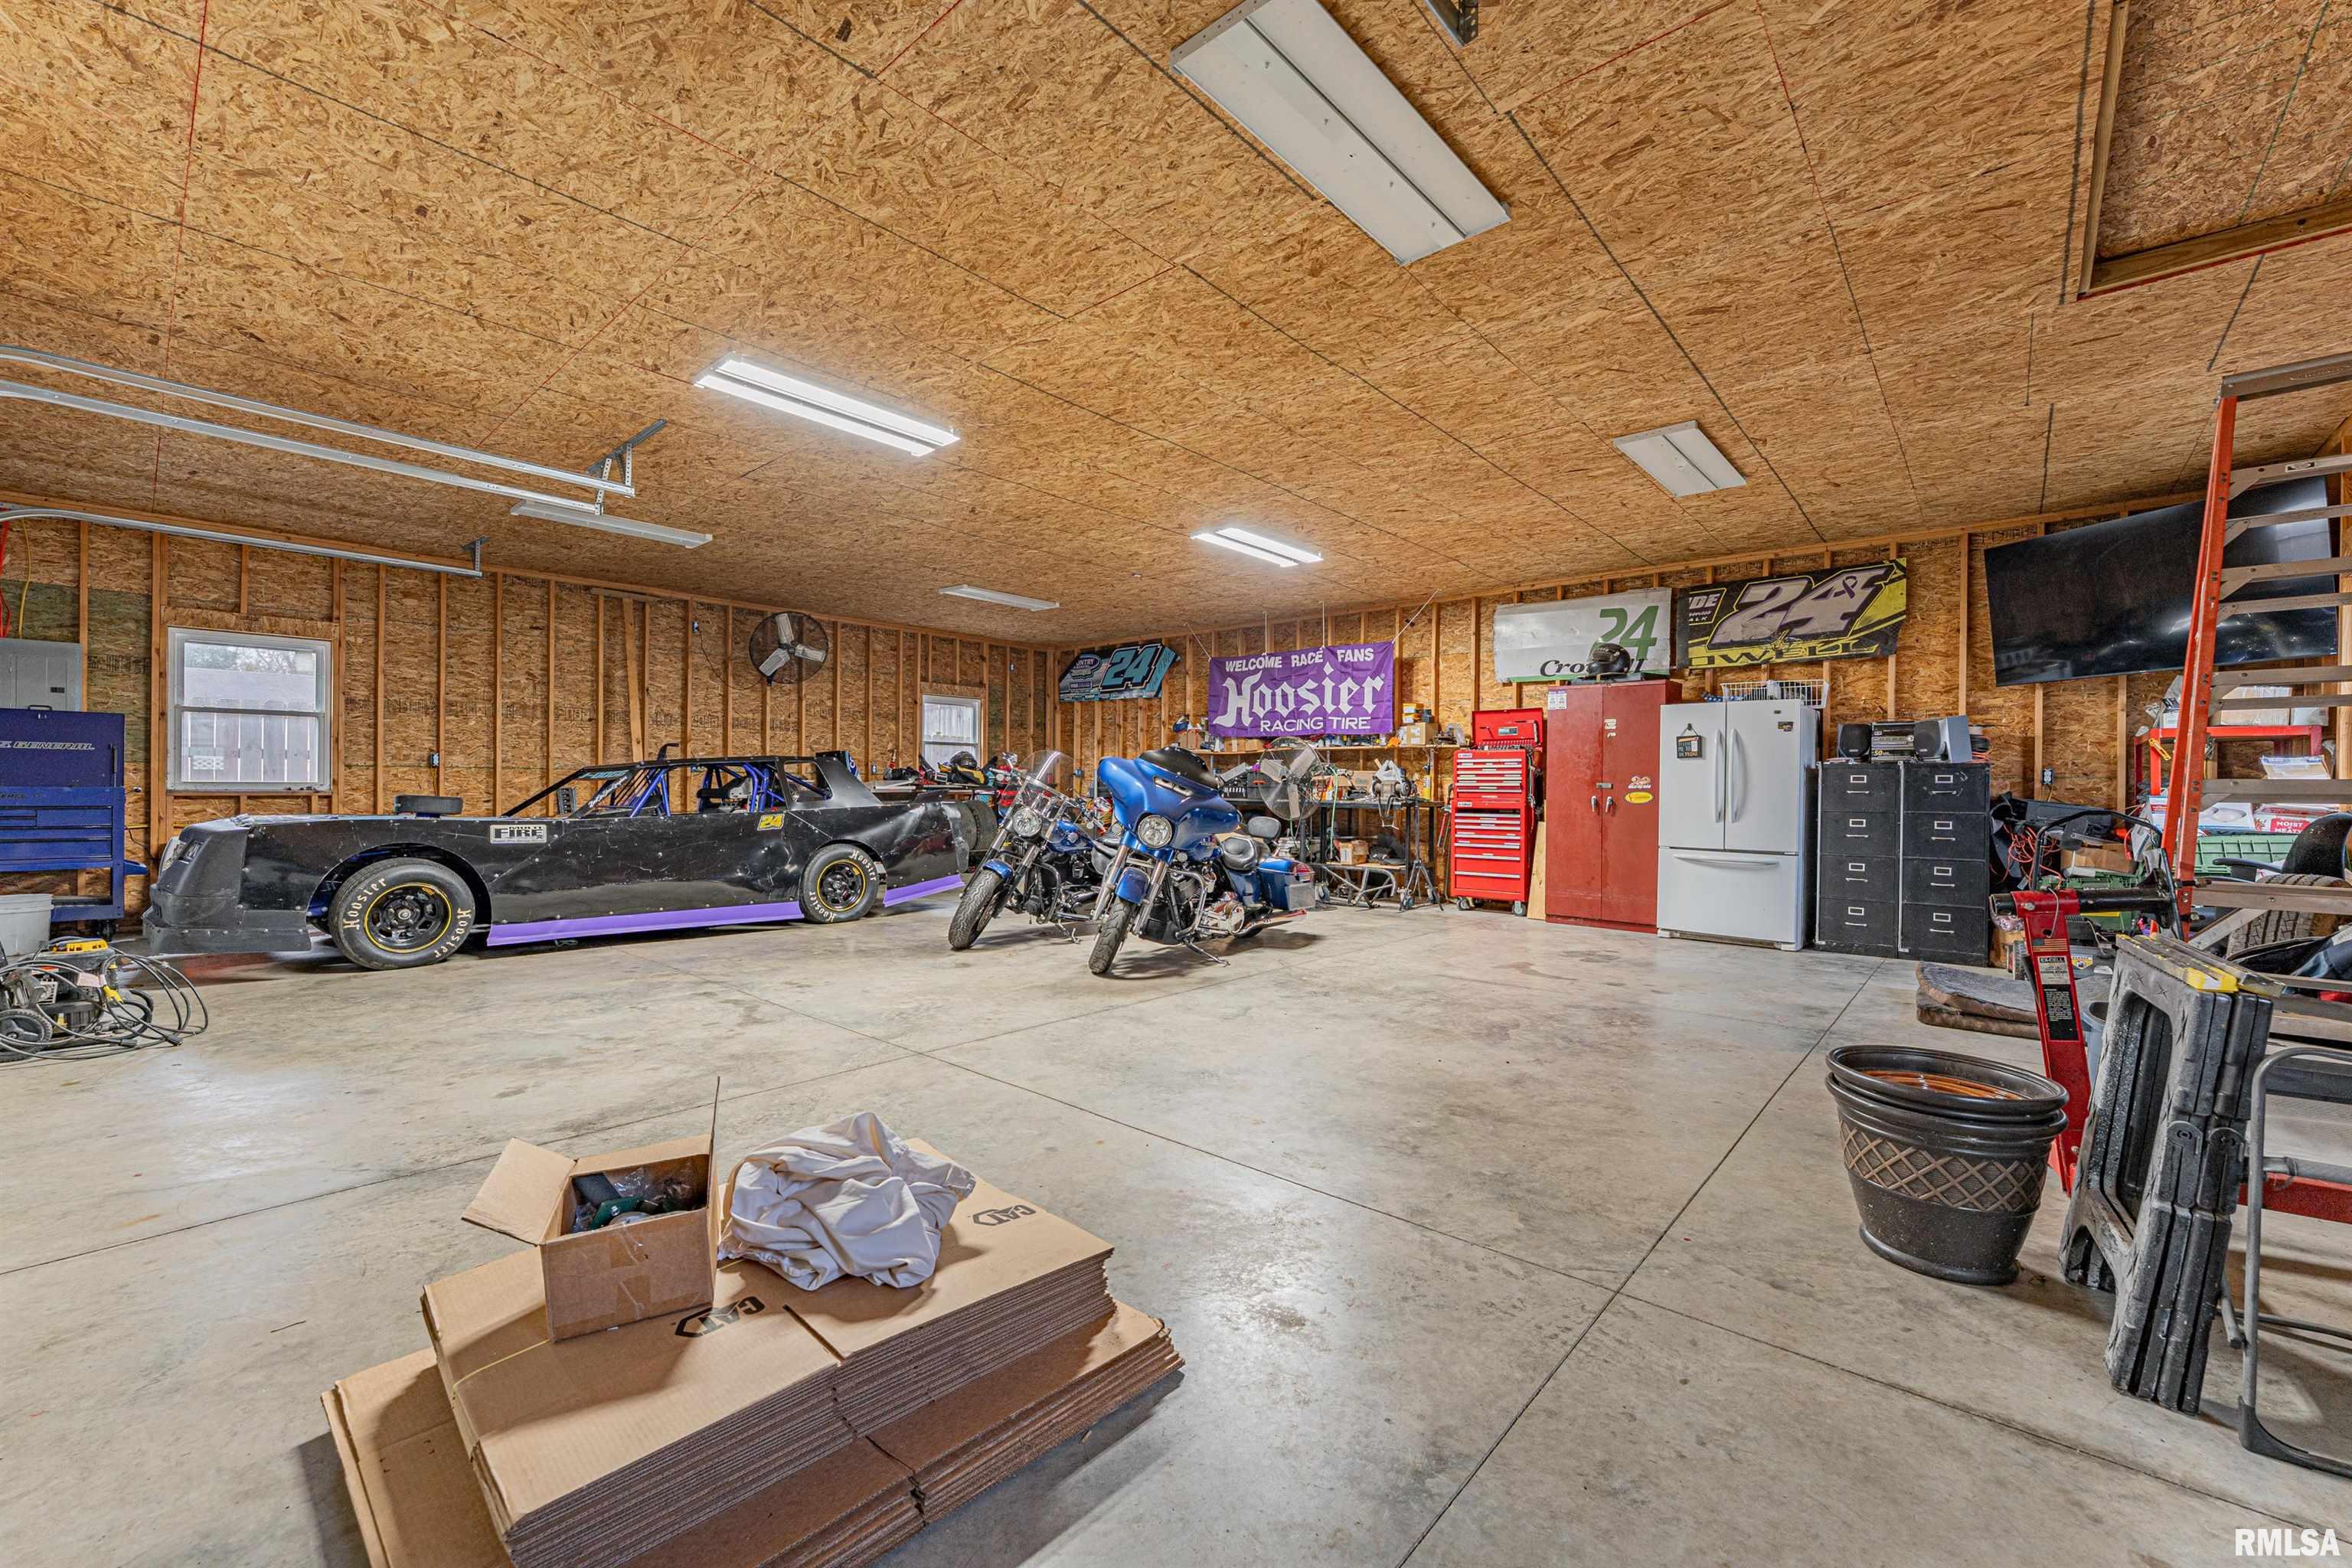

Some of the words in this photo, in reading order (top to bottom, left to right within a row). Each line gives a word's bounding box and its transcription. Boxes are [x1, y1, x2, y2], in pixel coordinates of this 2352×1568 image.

[1709, 567, 1891, 651] 24
[1588, 605, 1659, 662] 24
[1102, 645, 1161, 690] 24
[1225, 656, 1282, 672] WELCOME
[1292, 651, 1324, 668] RACE
[1338, 648, 1374, 662] FANS
[1689, 639, 1877, 666] OWELL
[1212, 662, 1384, 727] Hoosier
[1260, 717, 1324, 732] RACING
[1328, 717, 1371, 730] TIRE
[13, 740, 95, 750] GENERAL
[758, 814, 785, 831] 24
[849, 849, 877, 881] Hoosier
[343, 878, 387, 931] Hoosier
[809, 891, 837, 923] Hoosier
[434, 907, 472, 958] Hoosier
[986, 1204, 1037, 1226] CAT
[697, 1295, 766, 1335] CAT
